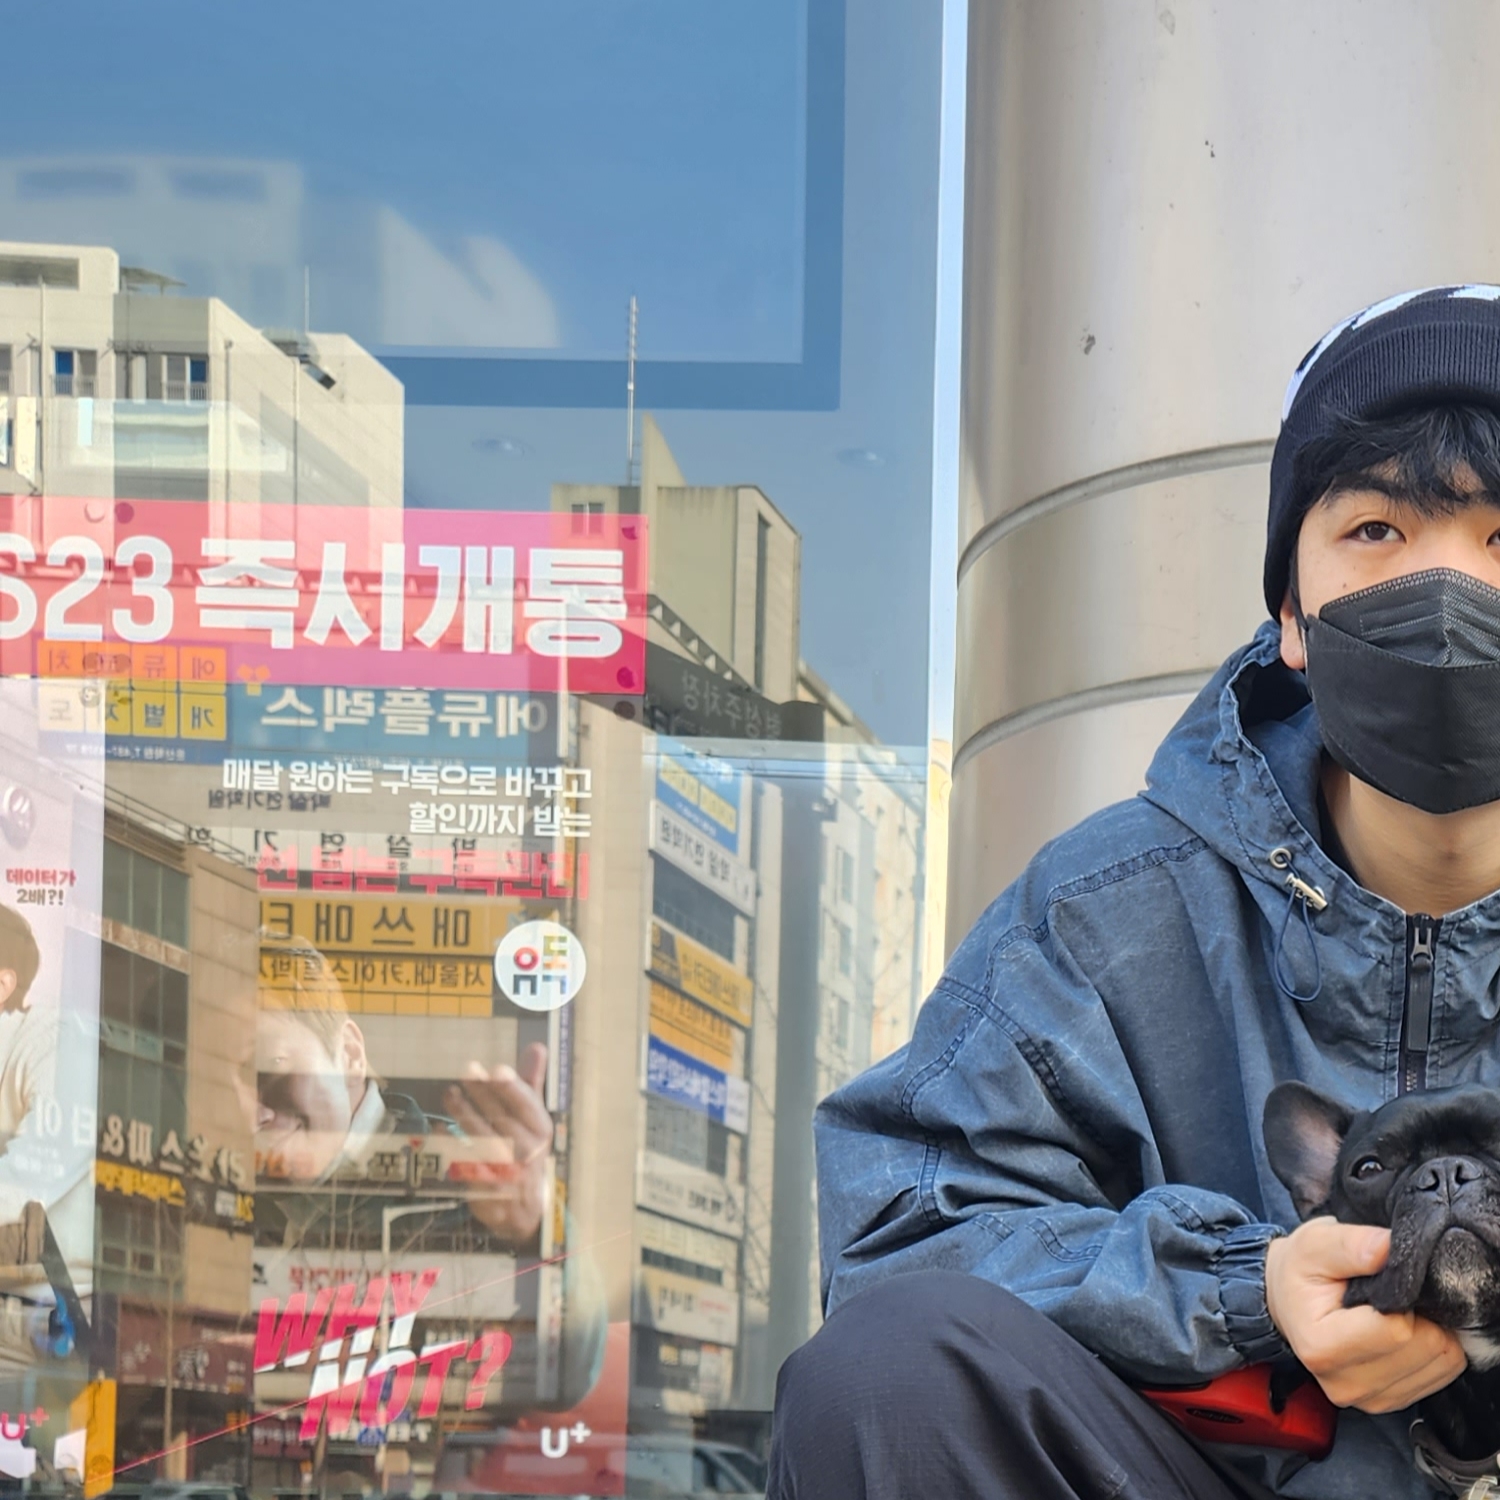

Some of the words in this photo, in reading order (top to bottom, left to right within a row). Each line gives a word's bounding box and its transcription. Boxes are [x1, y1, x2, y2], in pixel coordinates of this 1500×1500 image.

[195, 538, 628, 659] 즉시개통
[222, 758, 284, 791] 매달
[288, 761, 374, 795] 원하는
[380, 763, 497, 798] 구독으로
[504, 766, 593, 802] 바꾸고
[407, 802, 526, 836] 할인까지
[532, 804, 593, 838] 받는
[6, 868, 77, 888] 데이터가
[16, 888, 64, 906] 2배?!
[254, 1268, 444, 1373] WHY
[299, 1329, 513, 1441] NOT?
